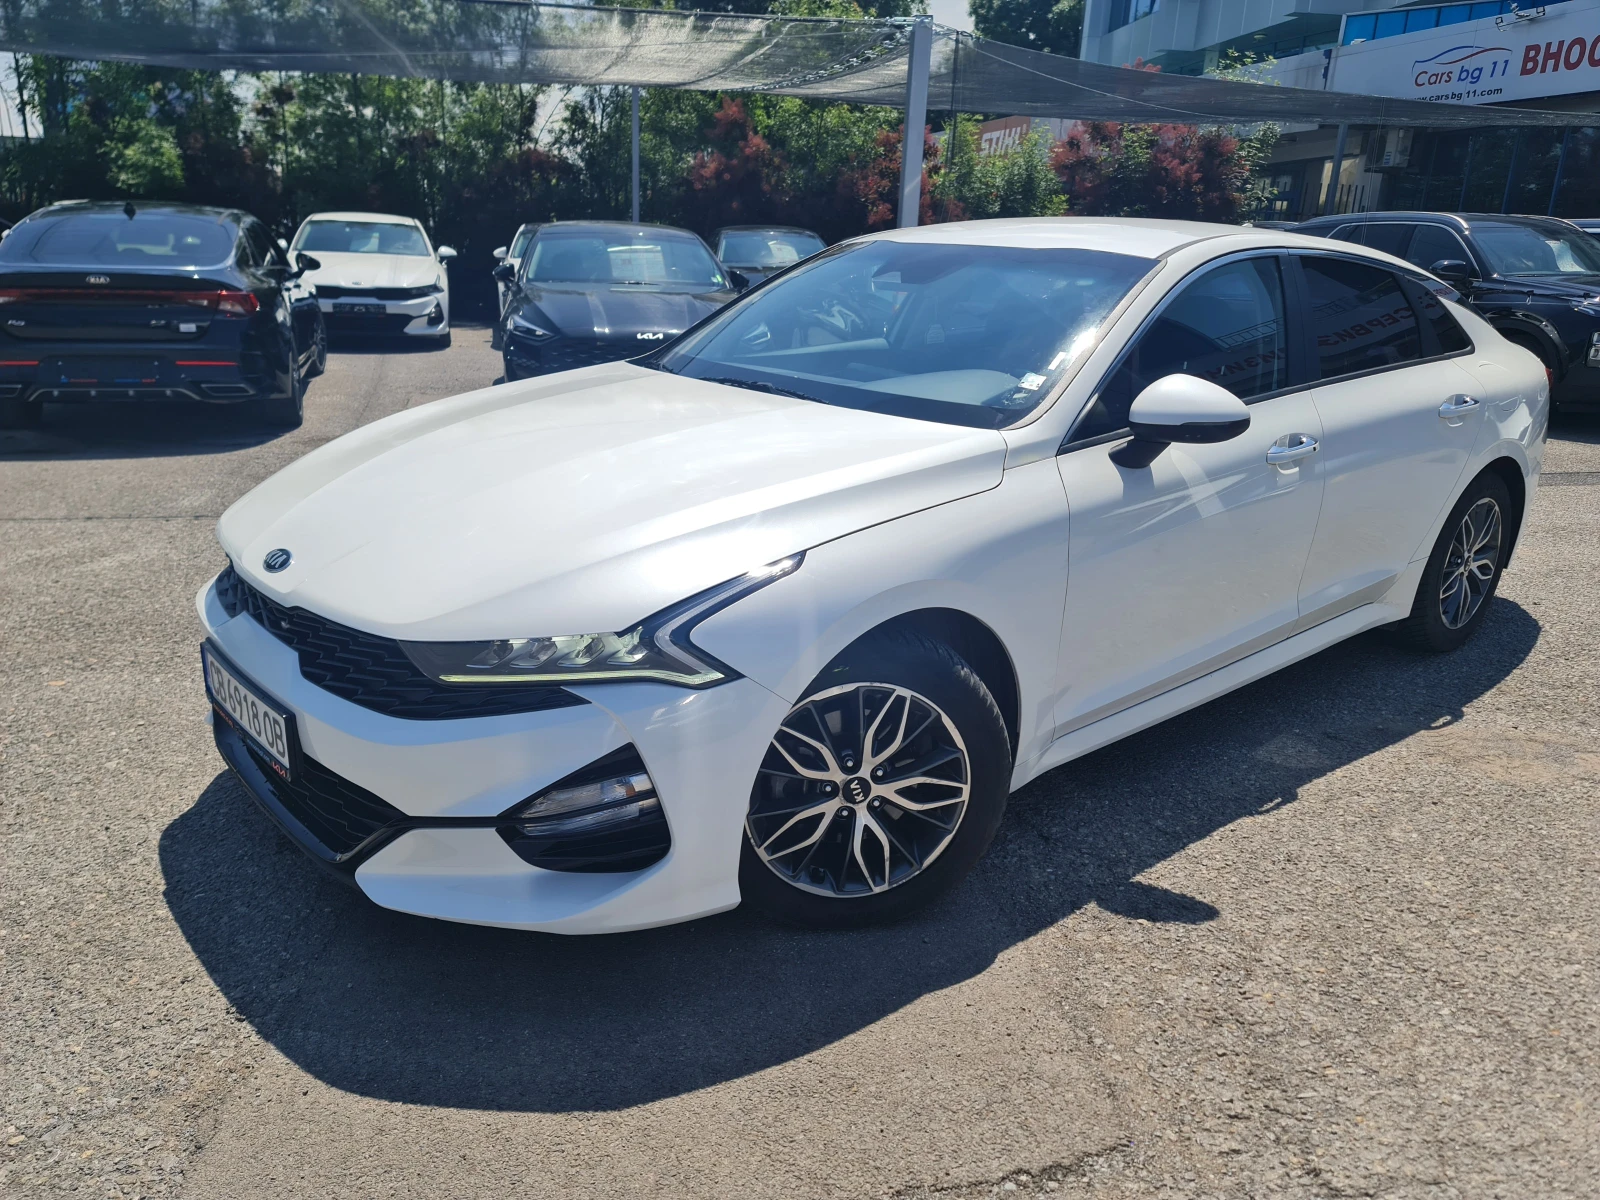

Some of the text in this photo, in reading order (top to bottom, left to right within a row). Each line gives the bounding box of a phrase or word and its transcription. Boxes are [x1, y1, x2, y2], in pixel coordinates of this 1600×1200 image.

[1414, 59, 1510, 88] Cars bg 11
[227, 679, 262, 738] 6918
[850, 779, 865, 803] KIA
